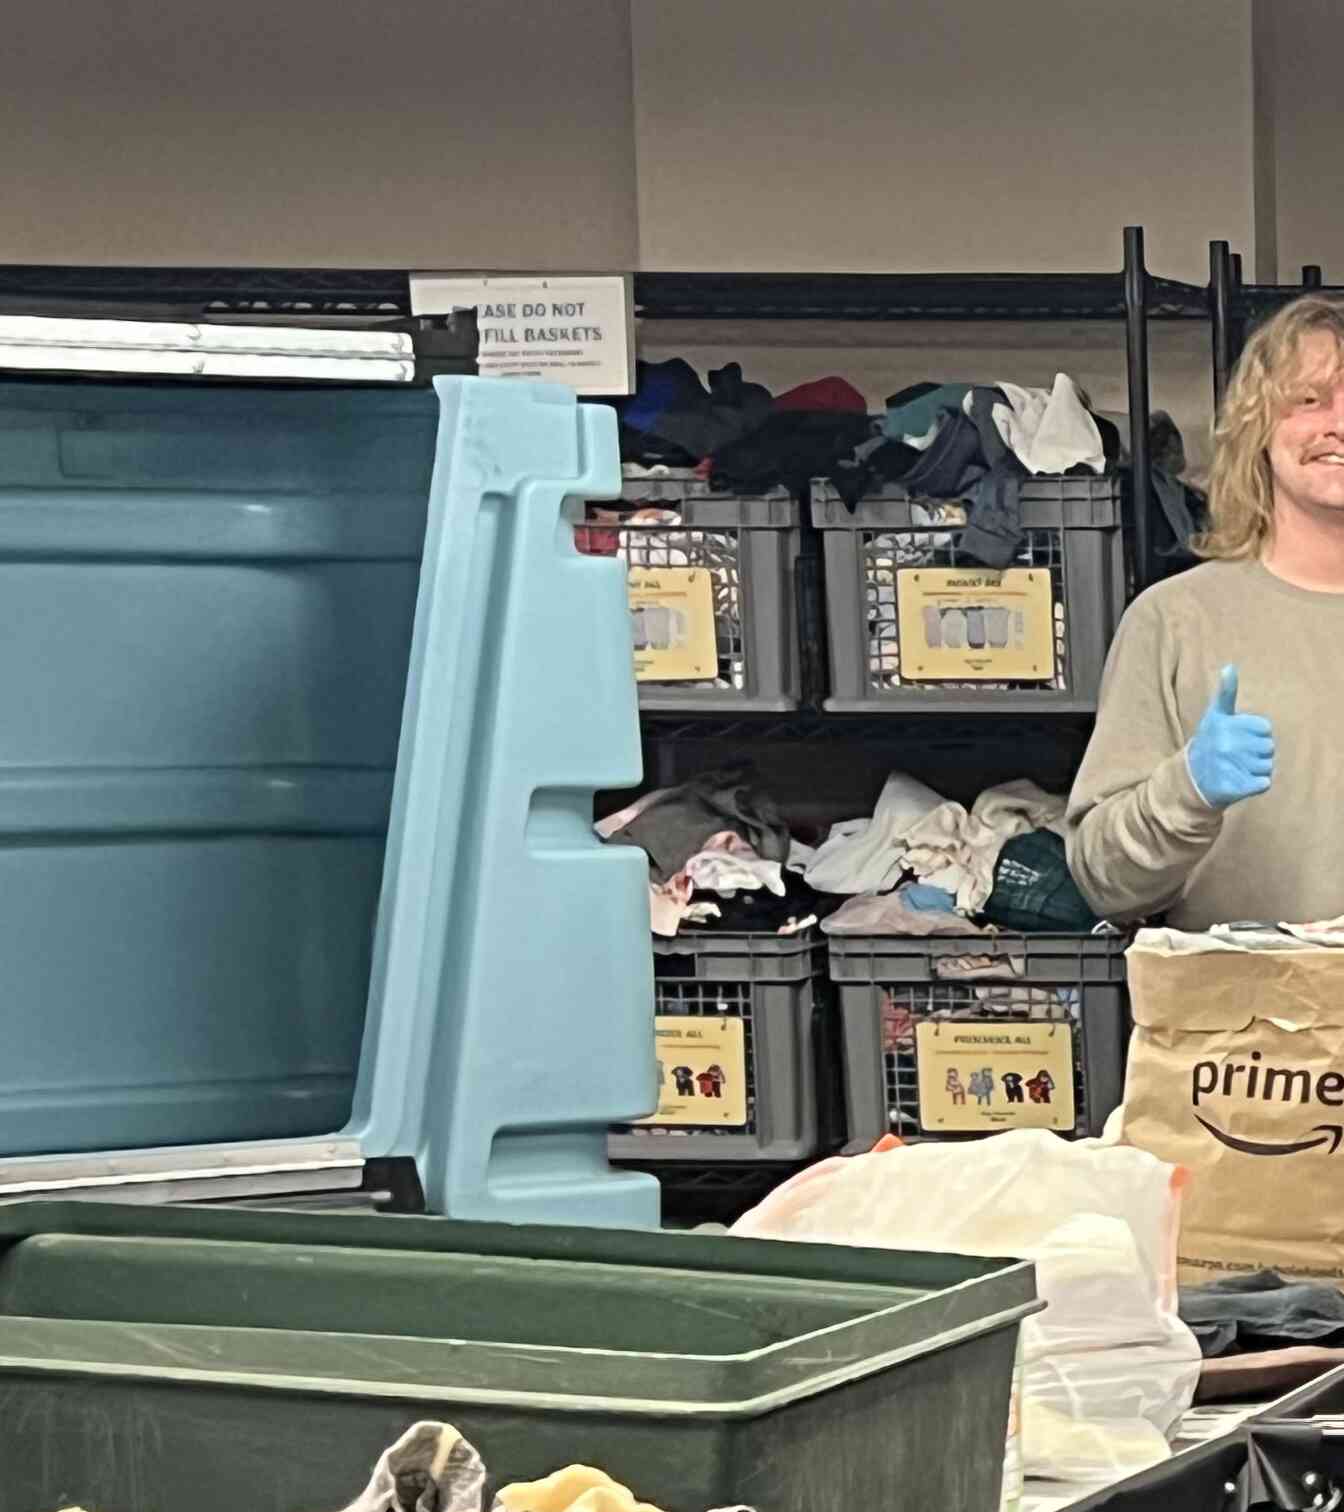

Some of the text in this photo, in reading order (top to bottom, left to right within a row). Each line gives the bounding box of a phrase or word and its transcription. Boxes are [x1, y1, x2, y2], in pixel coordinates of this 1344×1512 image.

[522, 302, 547, 318] DO
[552, 302, 585, 318] NOT
[524, 326, 603, 344] BASKETS
